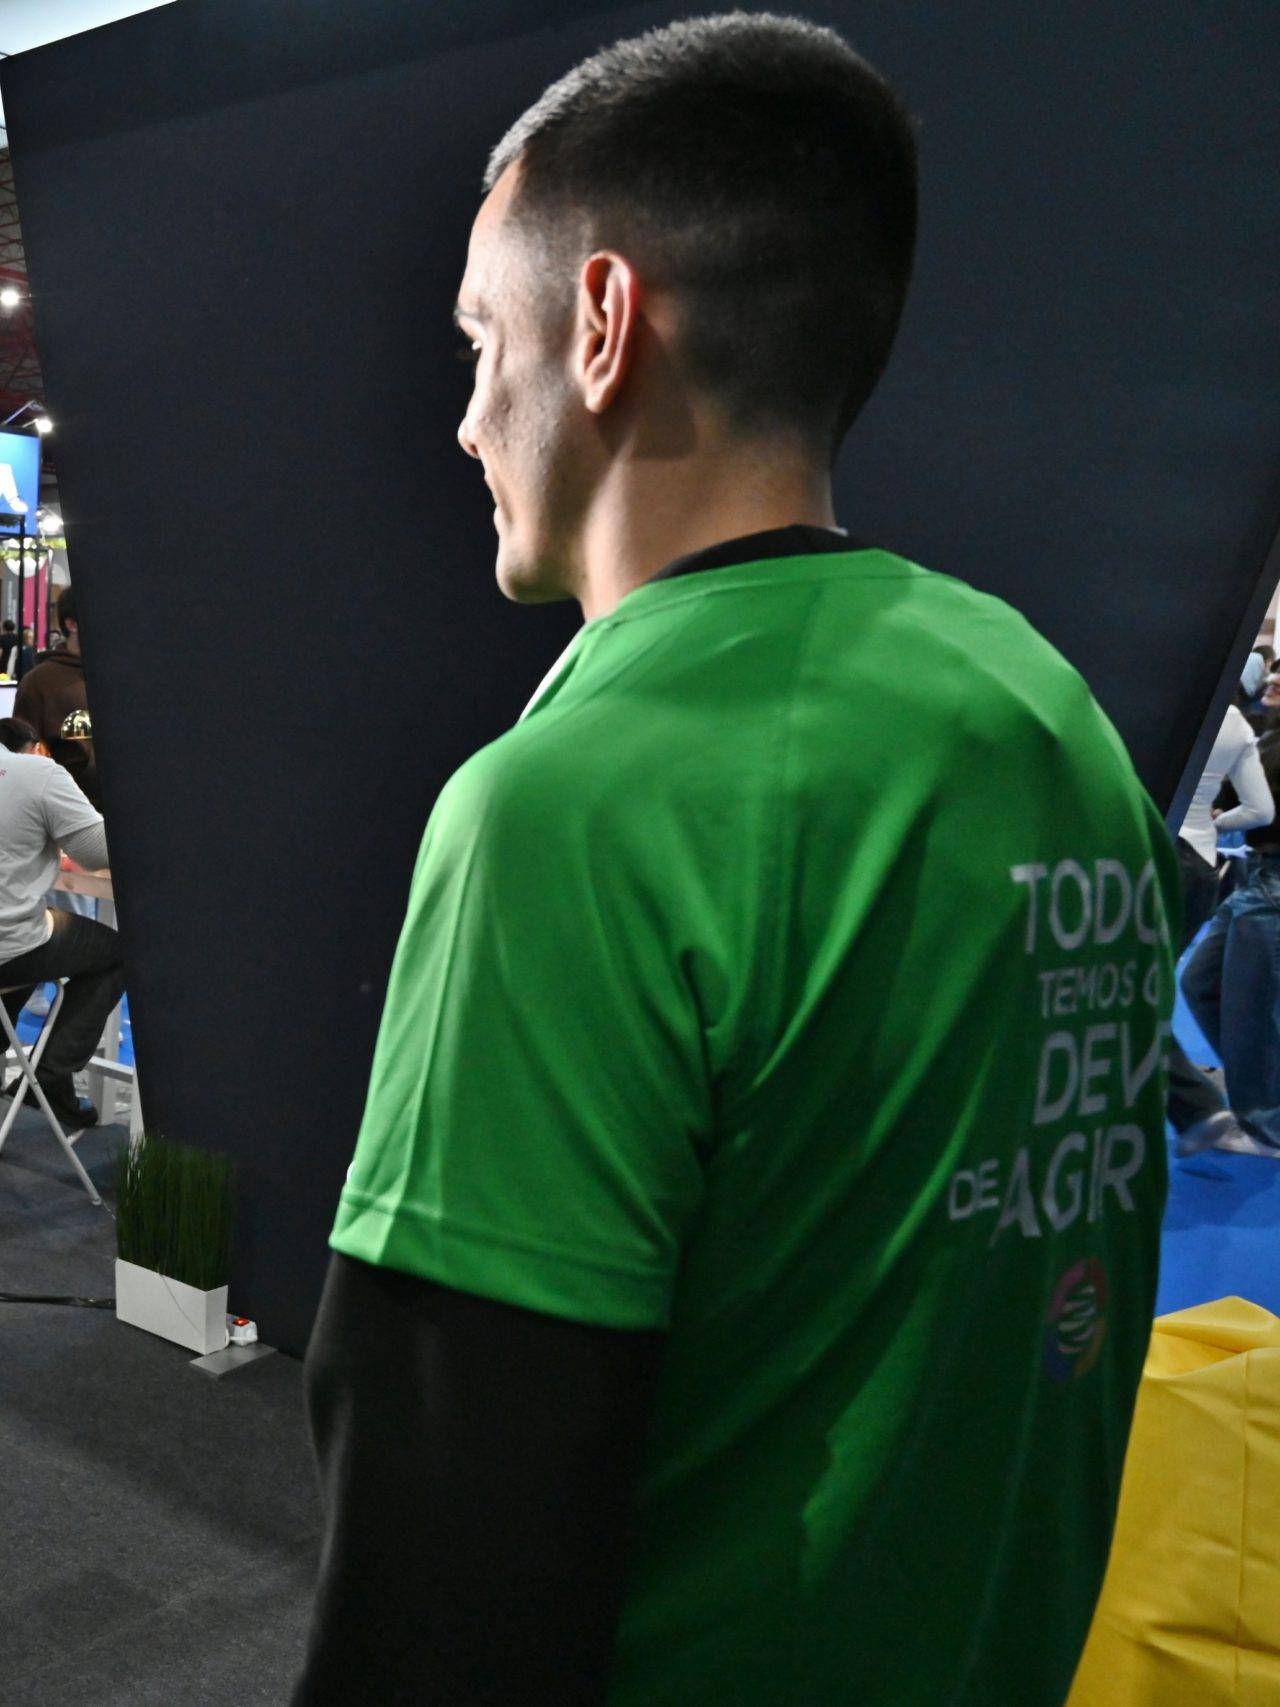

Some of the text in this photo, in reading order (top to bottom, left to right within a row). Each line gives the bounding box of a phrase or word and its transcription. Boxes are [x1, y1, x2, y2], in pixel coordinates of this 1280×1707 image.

[1009, 858, 1170, 955] TODO
[1037, 960, 1137, 1019] TEMOS
[947, 1124, 1146, 1248] DE AGIR
